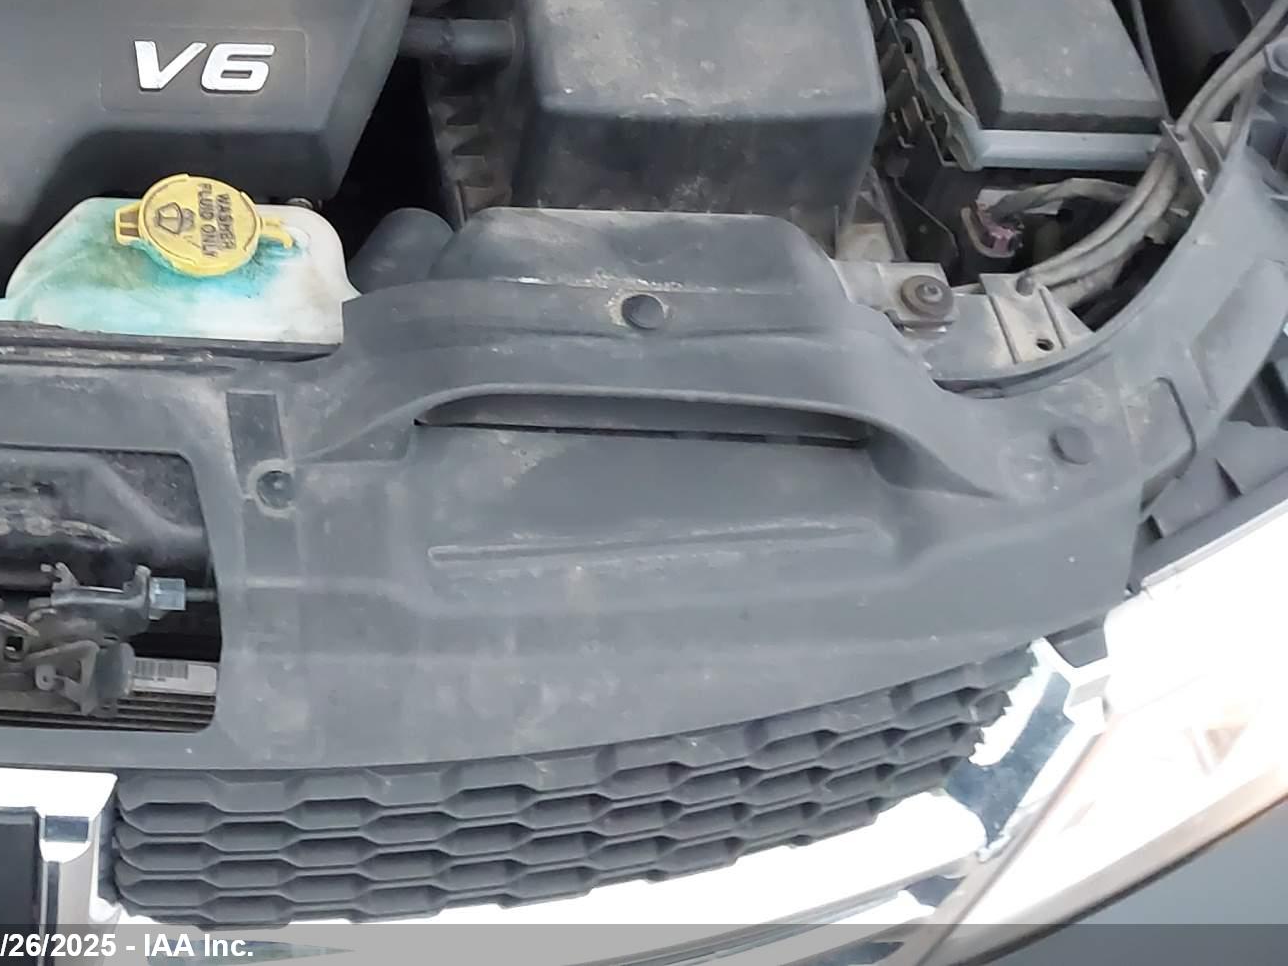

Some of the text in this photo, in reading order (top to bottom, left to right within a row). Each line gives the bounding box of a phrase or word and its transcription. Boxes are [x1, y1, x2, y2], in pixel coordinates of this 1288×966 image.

[134, 40, 275, 92] V6
[198, 183, 218, 257] FLUID ONLY
[216, 193, 236, 250] WASHER
